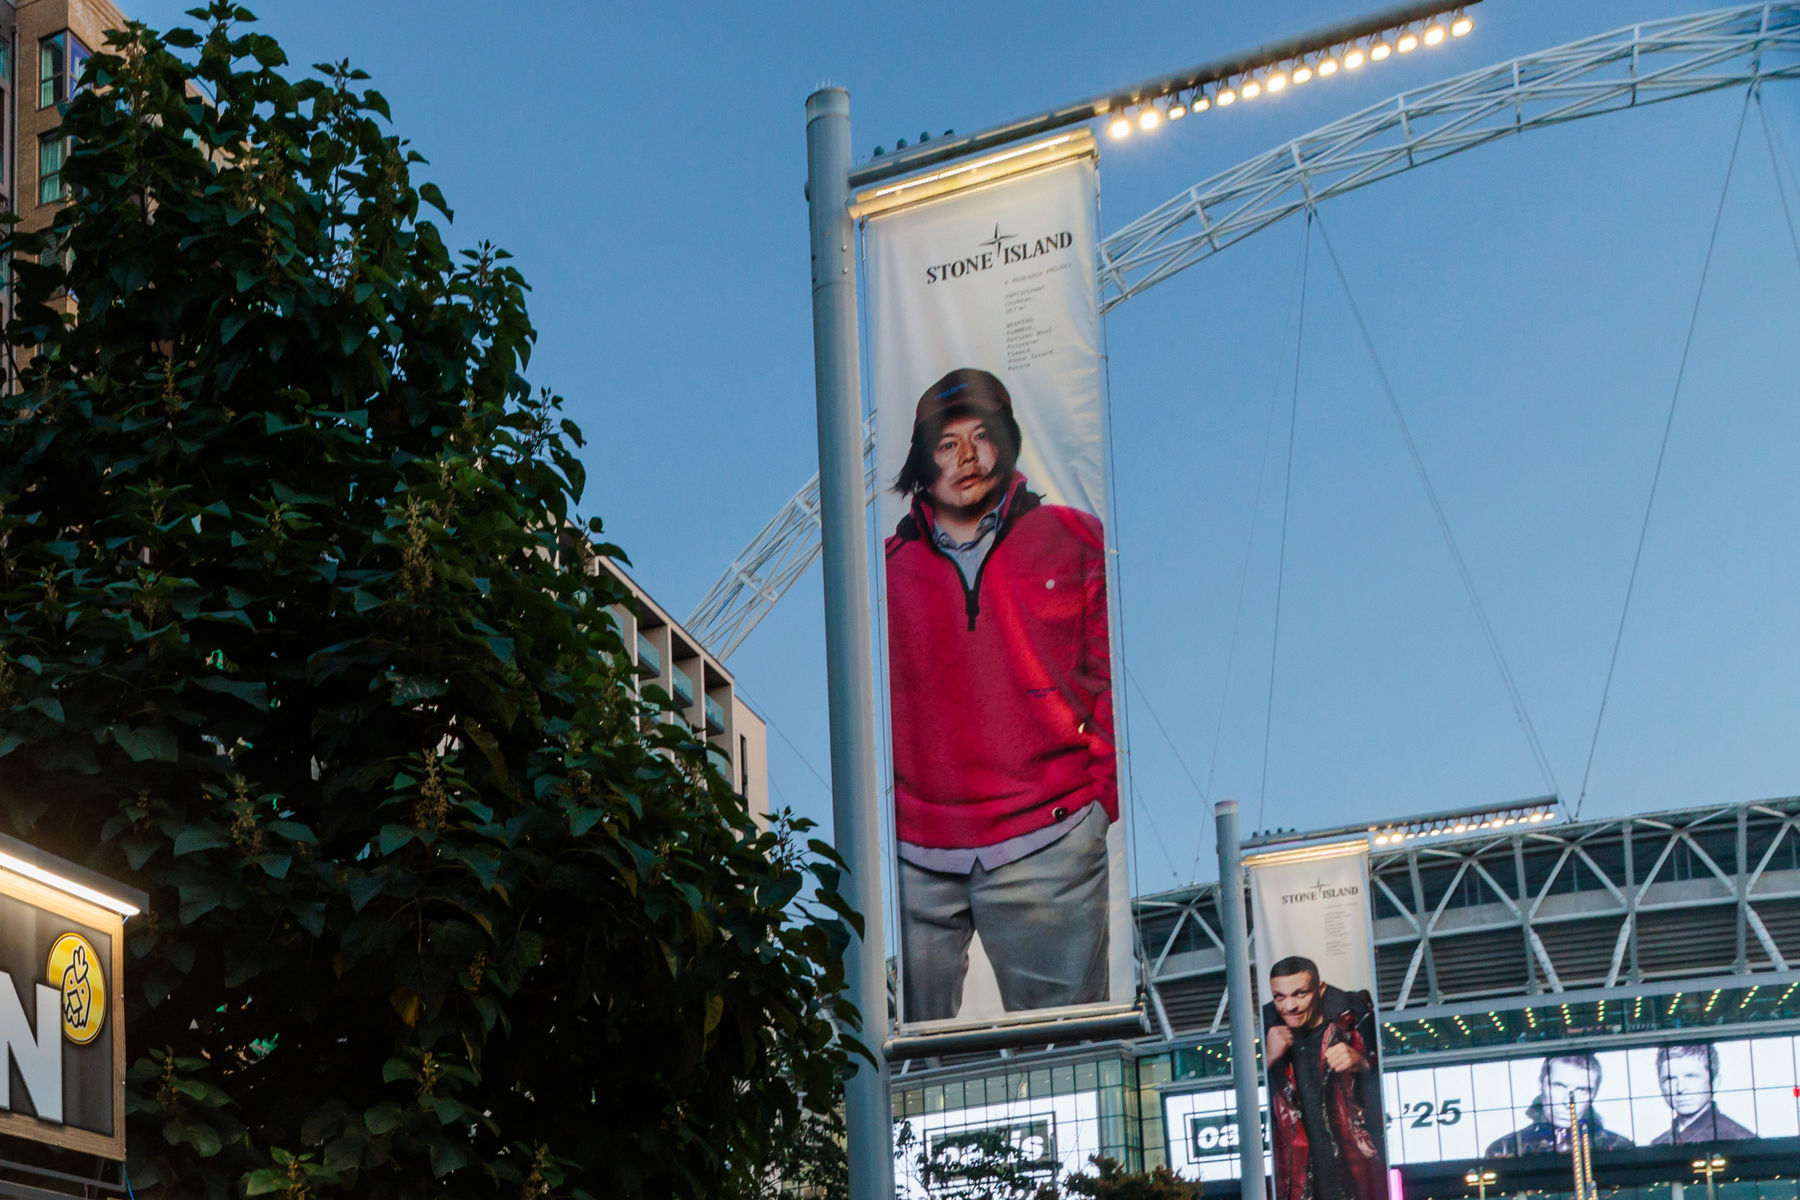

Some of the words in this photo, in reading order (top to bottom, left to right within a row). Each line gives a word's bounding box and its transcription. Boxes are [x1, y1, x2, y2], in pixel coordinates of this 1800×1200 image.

[927, 252, 993, 285] STONE
[1003, 231, 1073, 265] ISLAND
[1282, 891, 1318, 905] STONE
[1322, 886, 1359, 900] ISLAND
